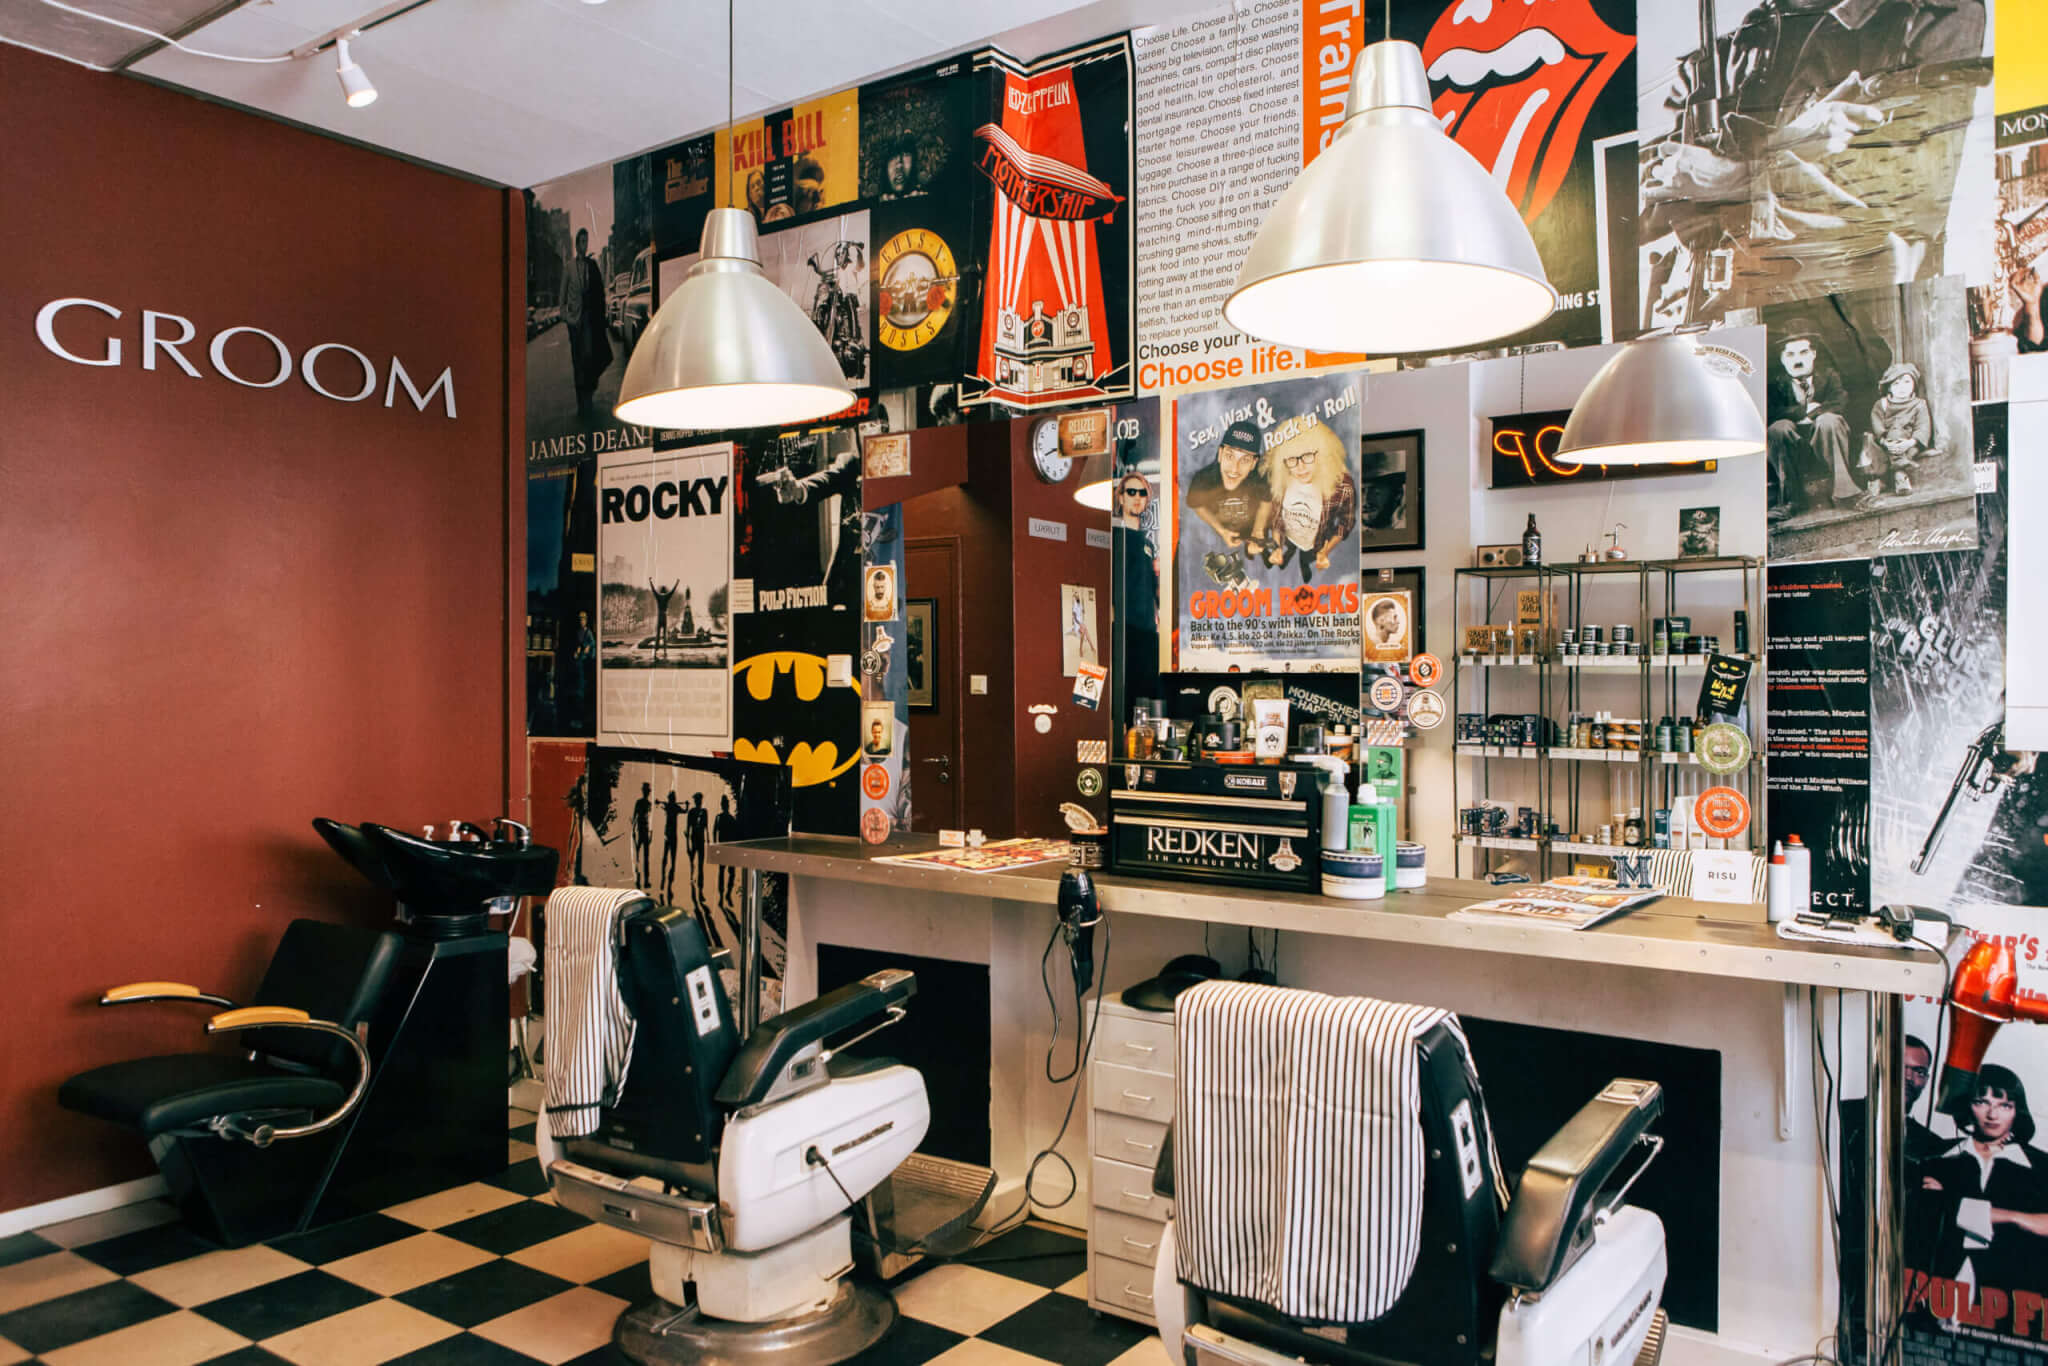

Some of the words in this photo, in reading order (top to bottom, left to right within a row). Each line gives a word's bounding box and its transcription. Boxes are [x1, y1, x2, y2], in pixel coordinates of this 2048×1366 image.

[1135, 32, 1169, 48] Choose
[1191, 15, 1225, 32] Choose
[1227, 13, 1234, 21] a
[1253, 0, 1289, 14] Choose
[1170, 35, 1205, 51] Choose
[1209, 32, 1215, 41] a
[1251, 11, 1288, 28] Choose
[1292, 8, 1298, 17] a
[1136, 59, 1166, 74] fucking
[1168, 54, 1181, 66] big
[1226, 34, 1259, 50] choose
[1261, 22, 1299, 40] washing
[1205, 50, 1242, 69] compact
[1245, 46, 1263, 58] disc
[1265, 37, 1298, 56] players
[1137, 87, 1153, 101] and
[1157, 75, 1198, 96] electrical
[1201, 73, 1213, 84] tin
[1260, 51, 1298, 68] Choose
[1137, 99, 1159, 117] good
[1198, 88, 1214, 99] low
[1280, 63, 1299, 77] and
[1137, 112, 1162, 128] dental
[1208, 95, 1241, 110] Choose
[1242, 86, 1263, 101] fixed
[1266, 78, 1298, 95] interest
[1137, 123, 1181, 141] mortgage
[1249, 97, 1288, 113] Choose
[1292, 94, 1299, 103] a
[733, 124, 776, 172] KILL
[783, 110, 827, 157] BILL
[1137, 141, 1166, 154] starter
[1200, 124, 1235, 139] Choose
[1239, 118, 1260, 133] your
[1137, 153, 1171, 167] Choose
[1175, 139, 1229, 159] leisurewear
[1232, 131, 1251, 146] and
[1254, 122, 1299, 140] matching
[1176, 157, 1211, 172] Choose
[1213, 156, 1219, 164] a
[1221, 143, 1273, 162] three-piece
[1276, 136, 1299, 150] suite
[981, 144, 1096, 219] MOTHERSHIP
[1137, 185, 1148, 194] on
[1150, 180, 1166, 192] hire
[1168, 172, 1208, 190] purchase
[1210, 168, 1218, 179] in
[1219, 168, 1225, 176] a
[1227, 162, 1254, 175] range
[1255, 156, 1264, 168] of
[1266, 151, 1299, 166] fucking
[1171, 186, 1206, 200] Choose
[1209, 179, 1225, 192] DIY
[1228, 174, 1247, 188] and
[1249, 165, 1299, 184] wondering
[882, 232, 926, 263] GUNS
[1138, 331, 1147, 341] to
[1148, 327, 1180, 341] replace
[1139, 340, 1199, 360] Choose
[1204, 333, 1241, 354] your
[35, 297, 457, 419] GROOM
[1139, 357, 1243, 389] Choose
[1252, 345, 1301, 374] life.
[1188, 424, 1219, 450] Sex,
[1219, 404, 1254, 431] Wax
[1256, 397, 1277, 430] &
[1263, 418, 1300, 451] Rock
[529, 432, 586, 461] JAMES
[592, 424, 647, 453] DEAN
[602, 476, 728, 524] ROCKY
[759, 590, 786, 612] PULP
[785, 585, 829, 610] FICTION
[1190, 588, 1273, 620] GROOM
[1279, 582, 1360, 616] ROCKS
[1190, 619, 1212, 633] Back
[1215, 620, 1224, 632] to
[1227, 619, 1243, 631] the
[1245, 618, 1267, 630] 90's
[1268, 617, 1292, 629] with
[1294, 616, 1330, 629] HAVEN
[1332, 615, 1360, 627] band
[1238, 631, 1250, 640] klo
[1307, 630, 1319, 638] On
[1320, 629, 1335, 638] The
[1337, 628, 1360, 638] Rocks
[1288, 685, 1361, 719] MOUSTACHES
[1147, 826, 1258, 860] REDKEN
[1177, 856, 1225, 867] AVENUE
[1234, 861, 1259, 870] NYC
[1612, 855, 1653, 889] M
[1707, 870, 1738, 881] RISU
[1904, 1267, 2008, 1329] PULP
